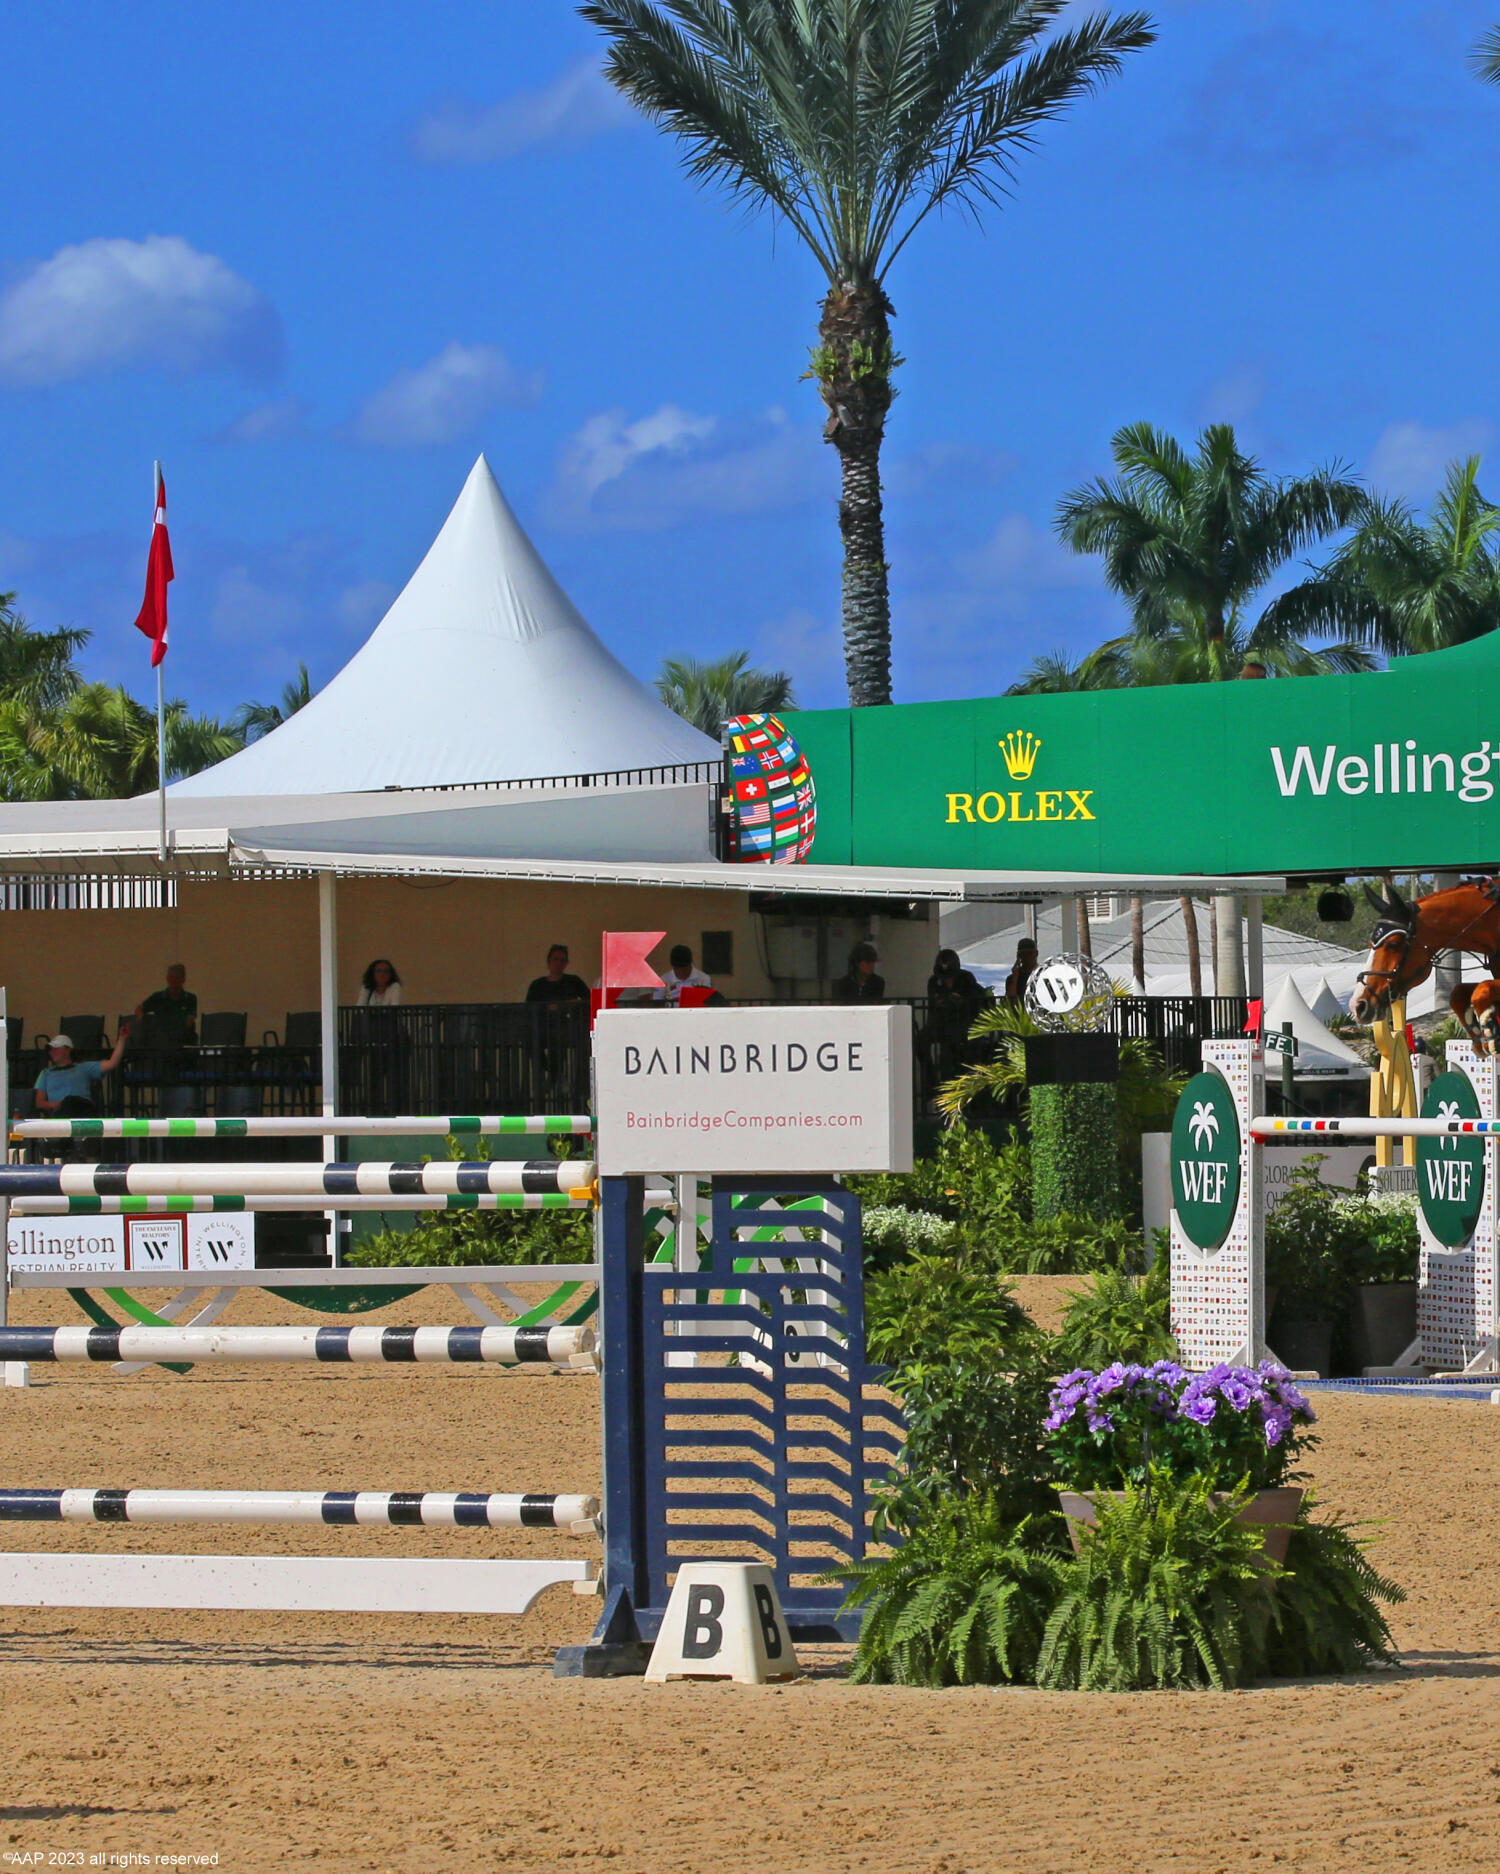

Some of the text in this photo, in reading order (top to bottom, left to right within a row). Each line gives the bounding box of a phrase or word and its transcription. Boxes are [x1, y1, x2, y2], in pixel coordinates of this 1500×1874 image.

[945, 790, 1097, 823] ROLEX
[625, 1042, 863, 1075] BAINBRIDGE
[626, 1110, 863, 1132] BainbridgeCompanies.com
[1179, 1160, 1229, 1204] WEF
[1425, 1159, 1473, 1202] WEF
[682, 1584, 725, 1659] B
[753, 1584, 782, 1659] B
